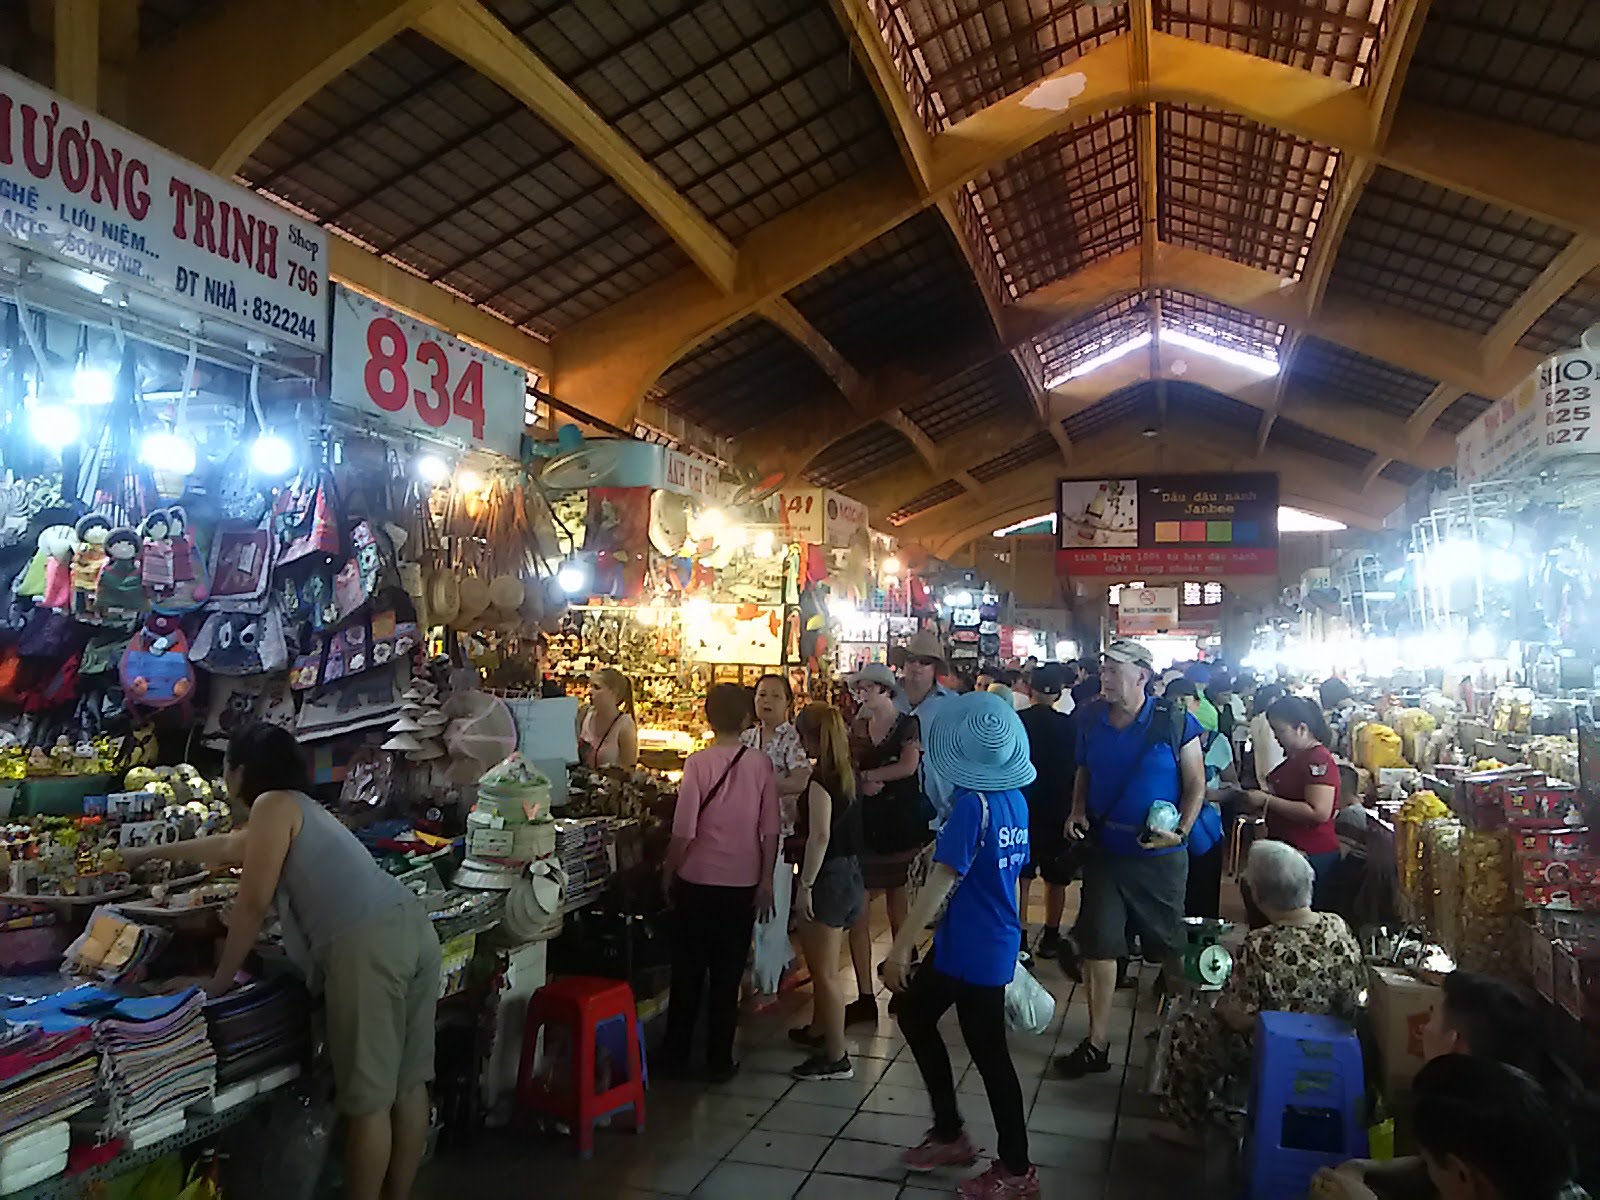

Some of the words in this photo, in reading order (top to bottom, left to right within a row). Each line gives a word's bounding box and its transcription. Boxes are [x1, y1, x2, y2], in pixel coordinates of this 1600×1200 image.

[169, 176, 279, 279] TRINH
[288, 224, 319, 262] Shop
[175, 265, 199, 297] ĐT
[204, 277, 237, 313] NHÀ
[252, 297, 316, 342] 8322244
[287, 260, 318, 297] 796
[364, 317, 486, 440] 834
